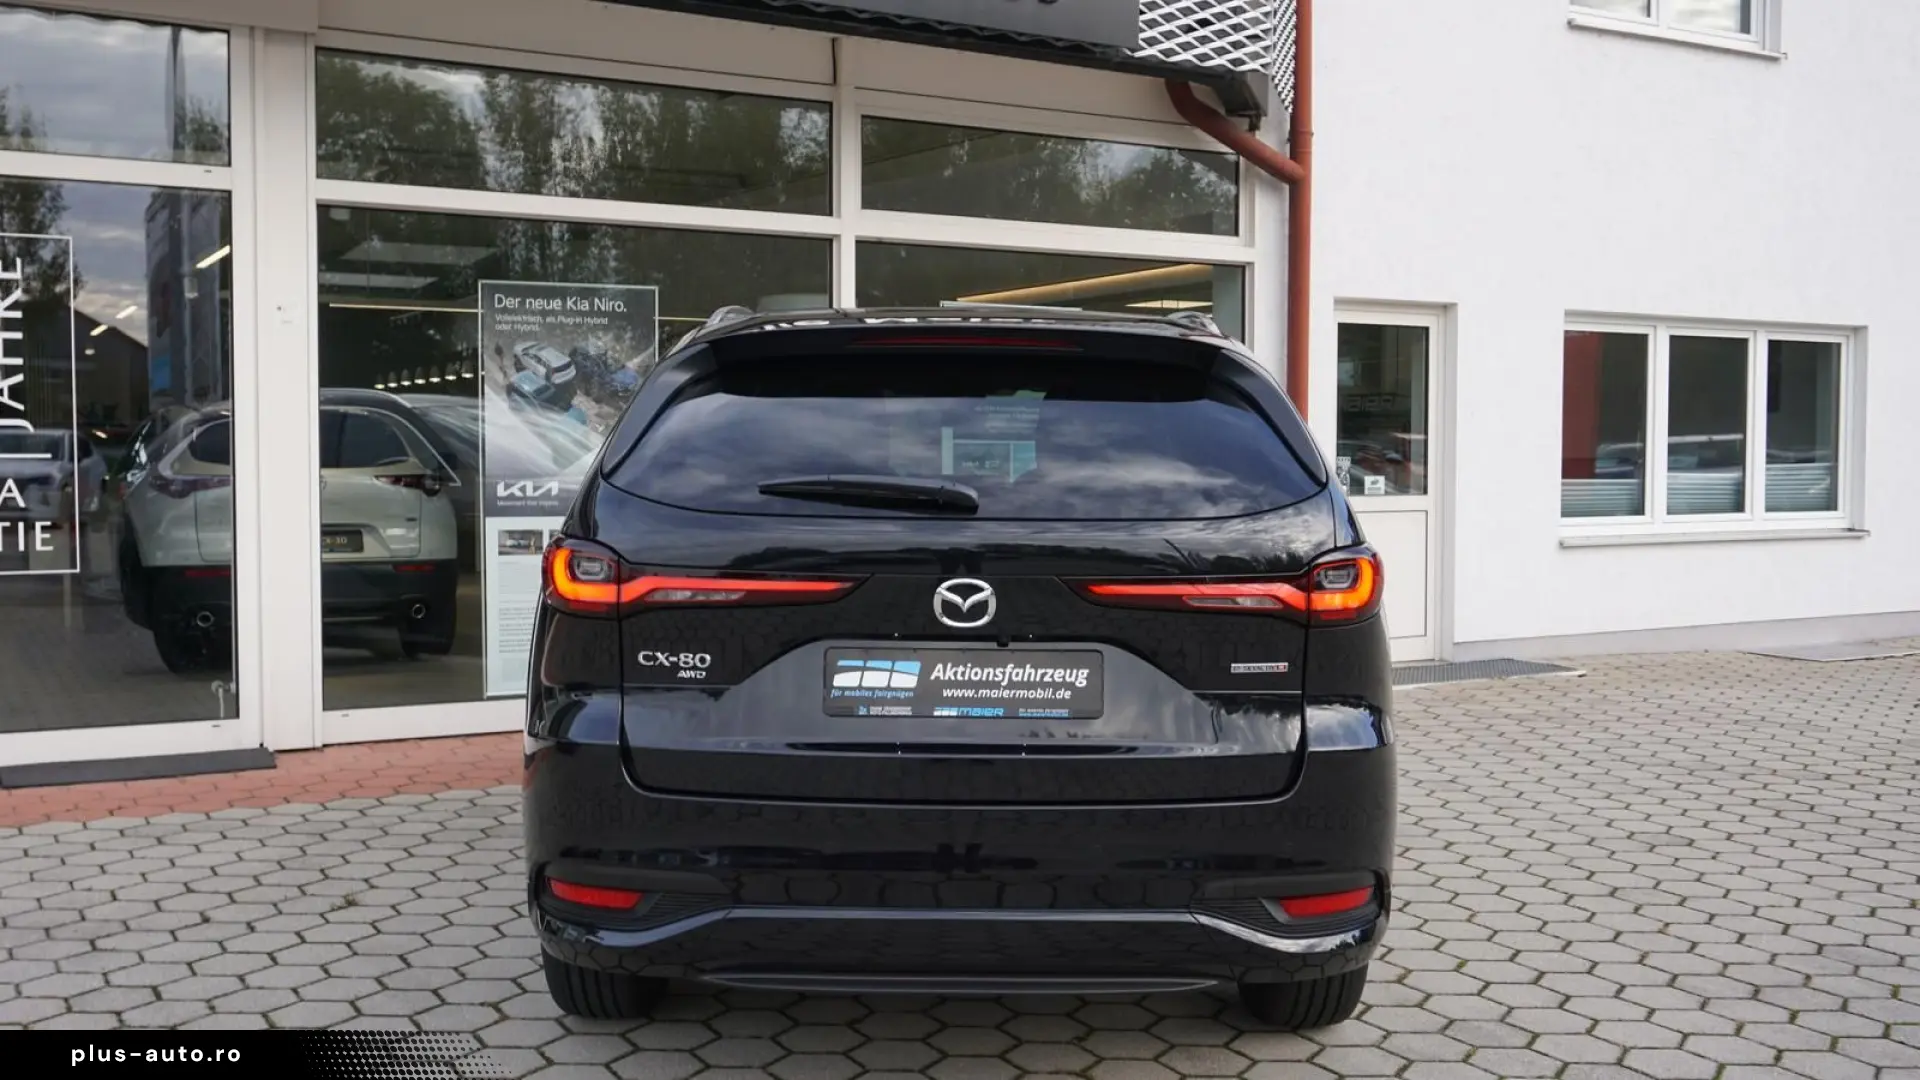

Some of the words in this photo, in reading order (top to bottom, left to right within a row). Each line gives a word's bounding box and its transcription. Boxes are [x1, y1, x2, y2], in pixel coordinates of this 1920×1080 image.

[494, 293, 522, 309] Der
[525, 297, 562, 310] neue
[566, 297, 590, 311] Kia
[594, 298, 628, 313] Niro.
[637, 650, 712, 669] CX-80
[677, 670, 707, 679] AWD
[930, 662, 1090, 688] Aktionsfahrzeug
[942, 687, 1073, 700] www.maiermobil.de
